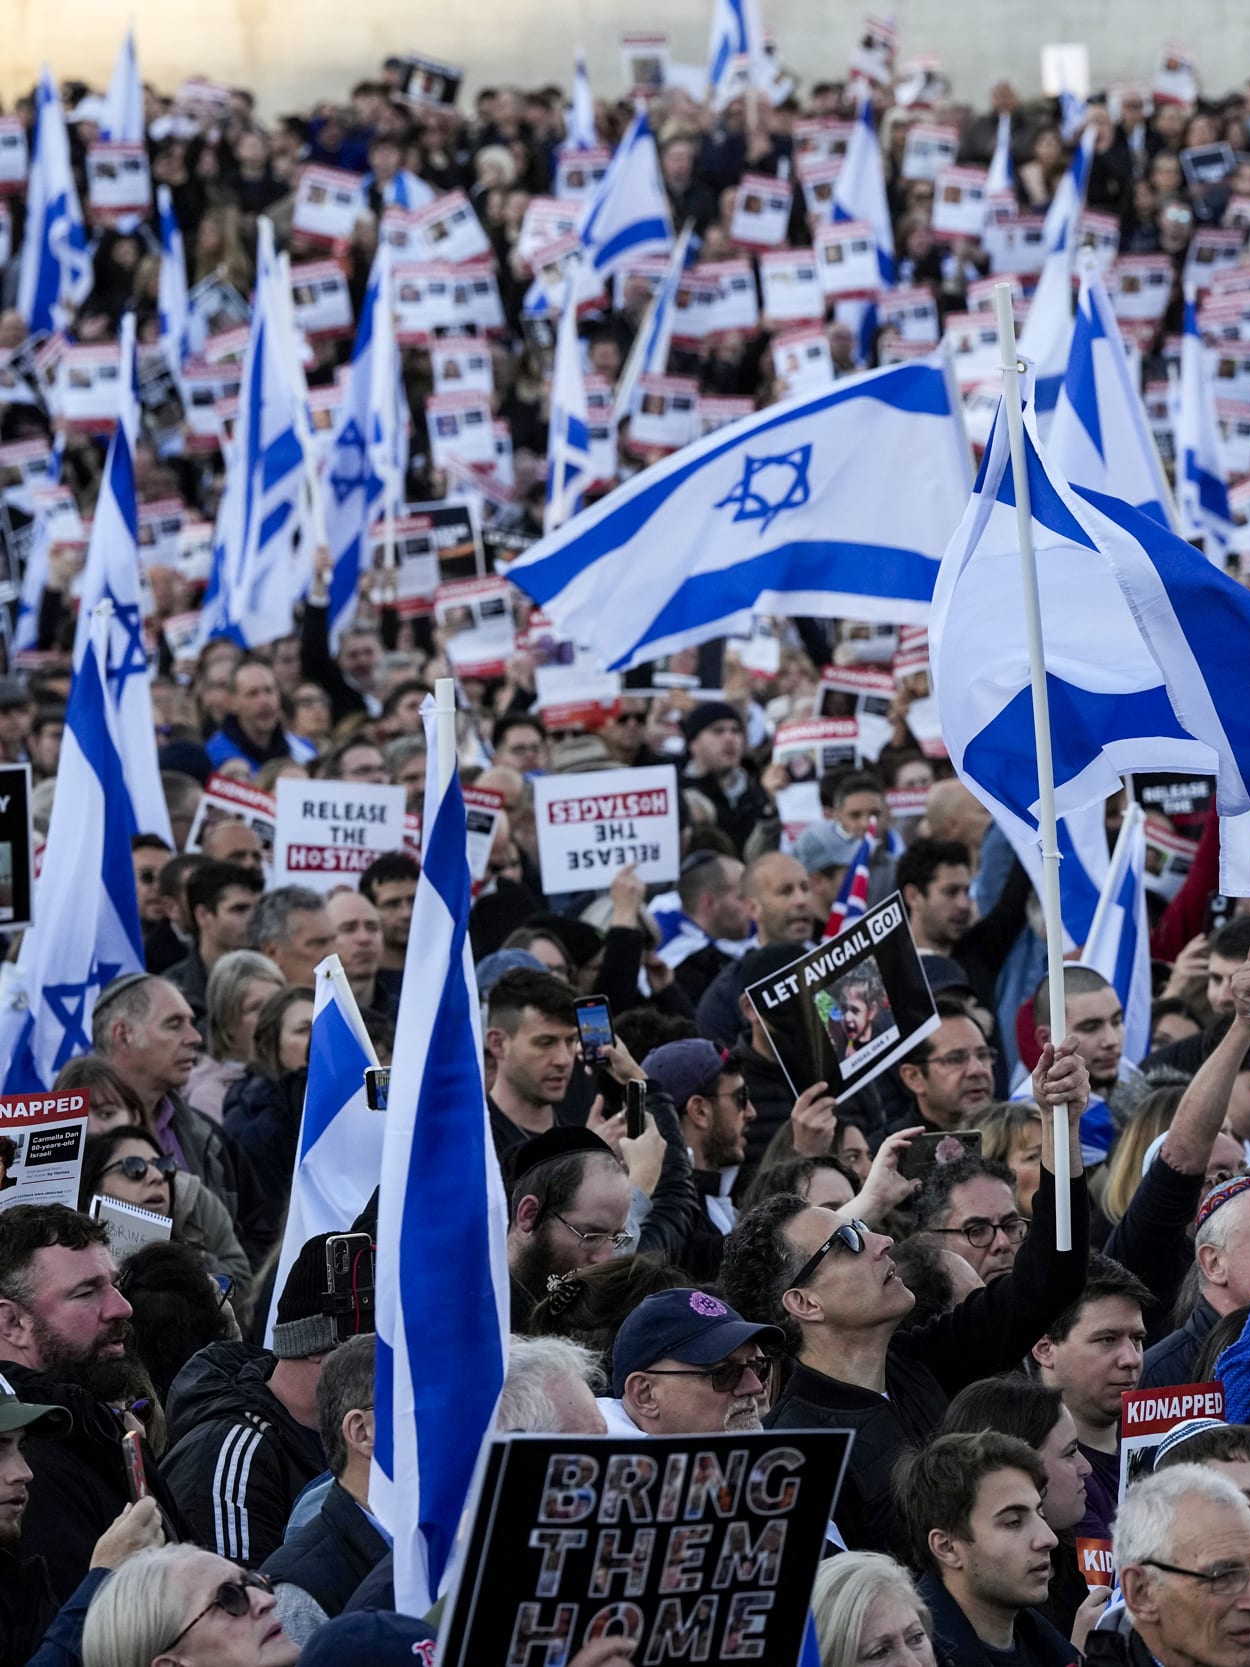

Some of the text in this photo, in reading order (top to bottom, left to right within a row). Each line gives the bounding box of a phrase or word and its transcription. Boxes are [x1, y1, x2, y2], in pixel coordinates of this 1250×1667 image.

[302, 800, 387, 824] RELEASE
[551, 792, 667, 822] HOSTAGES
[330, 826, 367, 846] THE
[595, 821, 638, 842] THE
[290, 847, 379, 870] HOSTAG
[567, 843, 661, 871] RELEASE
[761, 906, 900, 1009] LET AVIGAIL GO!
[0, 1095, 84, 1119] NAPPED
[32, 1131, 79, 1144] Carmella Dan
[30, 1150, 52, 1158] Israeli
[1127, 1392, 1223, 1424] KIDNAPPED
[537, 1447, 806, 1523] BRING
[529, 1519, 788, 1598] THEM
[506, 1591, 775, 1667] HOME
